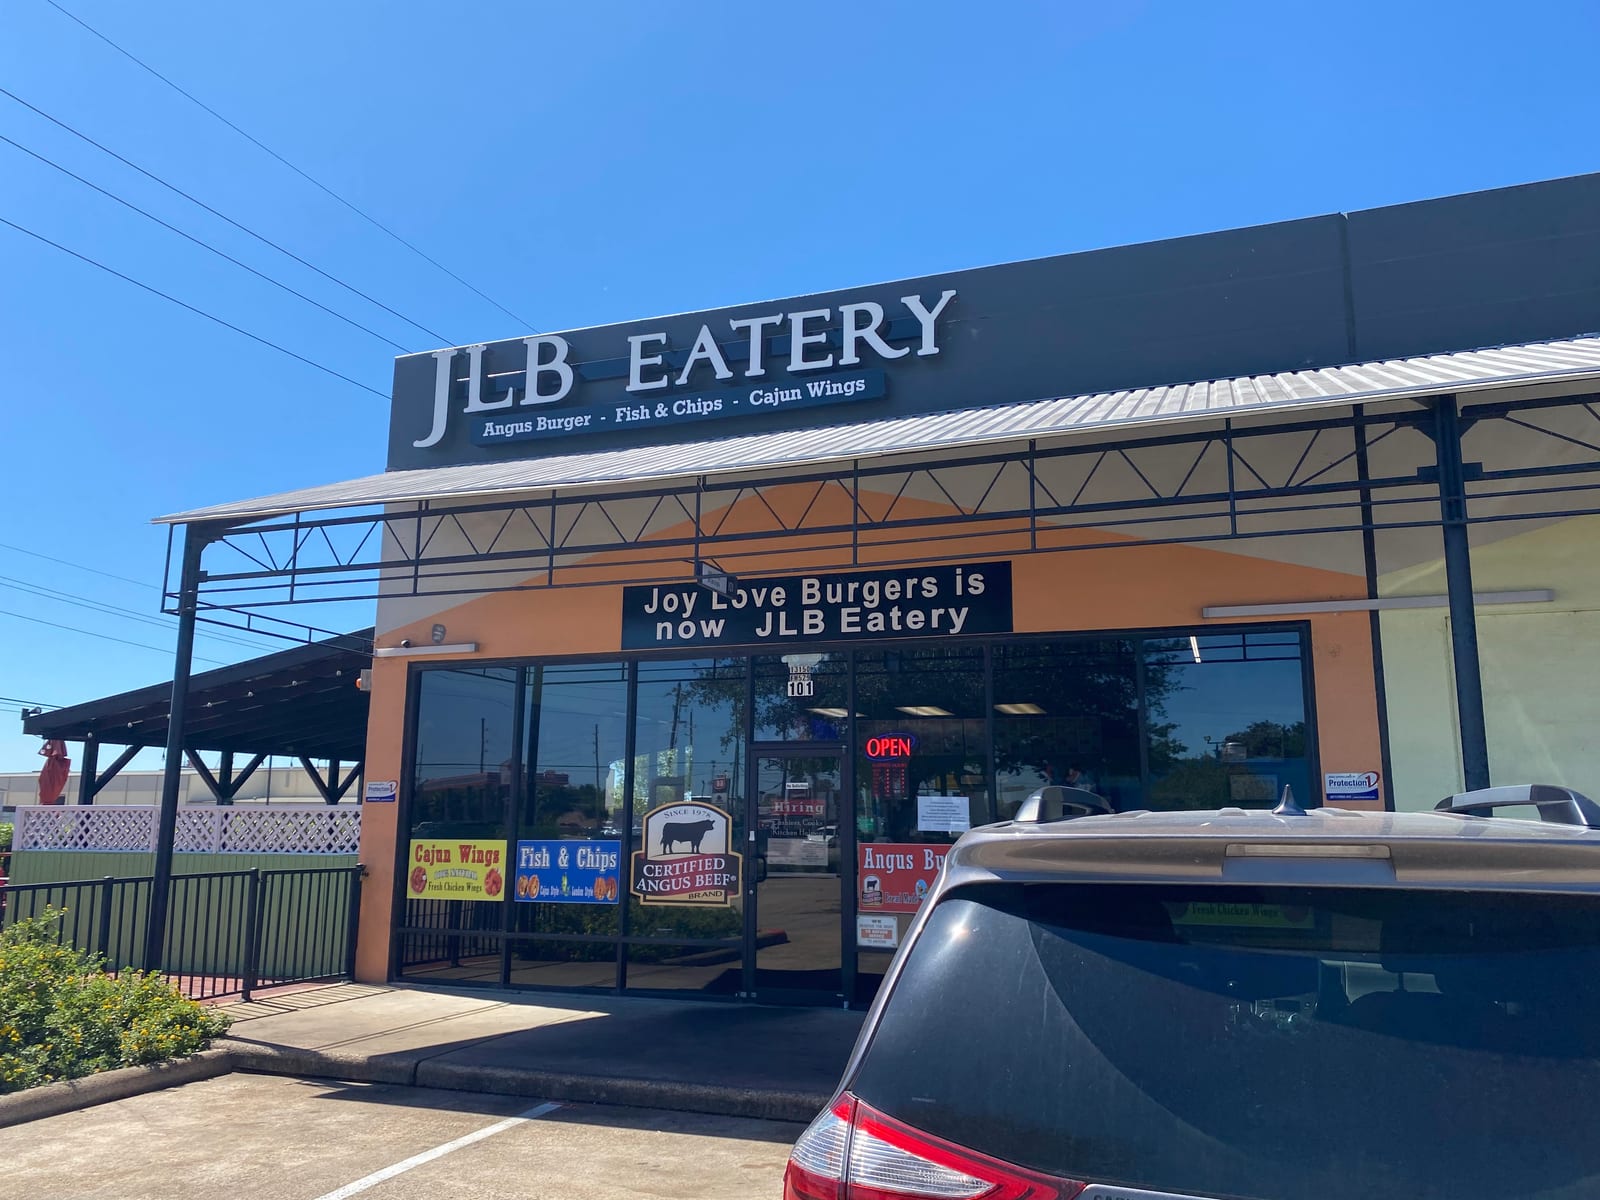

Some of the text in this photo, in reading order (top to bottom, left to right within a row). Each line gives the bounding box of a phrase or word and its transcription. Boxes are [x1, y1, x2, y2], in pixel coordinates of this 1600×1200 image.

[413, 290, 956, 448] JLB EATERY
[483, 422, 532, 437] Angus
[536, 414, 592, 431] Burger
[615, 405, 650, 422] Fish
[655, 403, 668, 417] &
[673, 398, 722, 415] Chips
[750, 387, 802, 406] Cajun
[807, 379, 865, 397] Wings
[644, 569, 985, 618] Joy Love Burgers is
[656, 606, 969, 640] now JLB Eatery
[790, 681, 812, 696] 101
[866, 738, 911, 758] OPEN
[1329, 779, 1366, 787] Protection
[692, 809, 712, 818] 1978
[774, 801, 824, 815] Hiring
[415, 844, 499, 867] Cajun Wings
[520, 846, 617, 873] Fish & Chips
[864, 848, 913, 873] Angus
[643, 858, 725, 877] CERTIFIED
[444, 882, 464, 891] Chicken
[636, 877, 691, 892] ANGUS
[688, 890, 723, 899] BRAND
